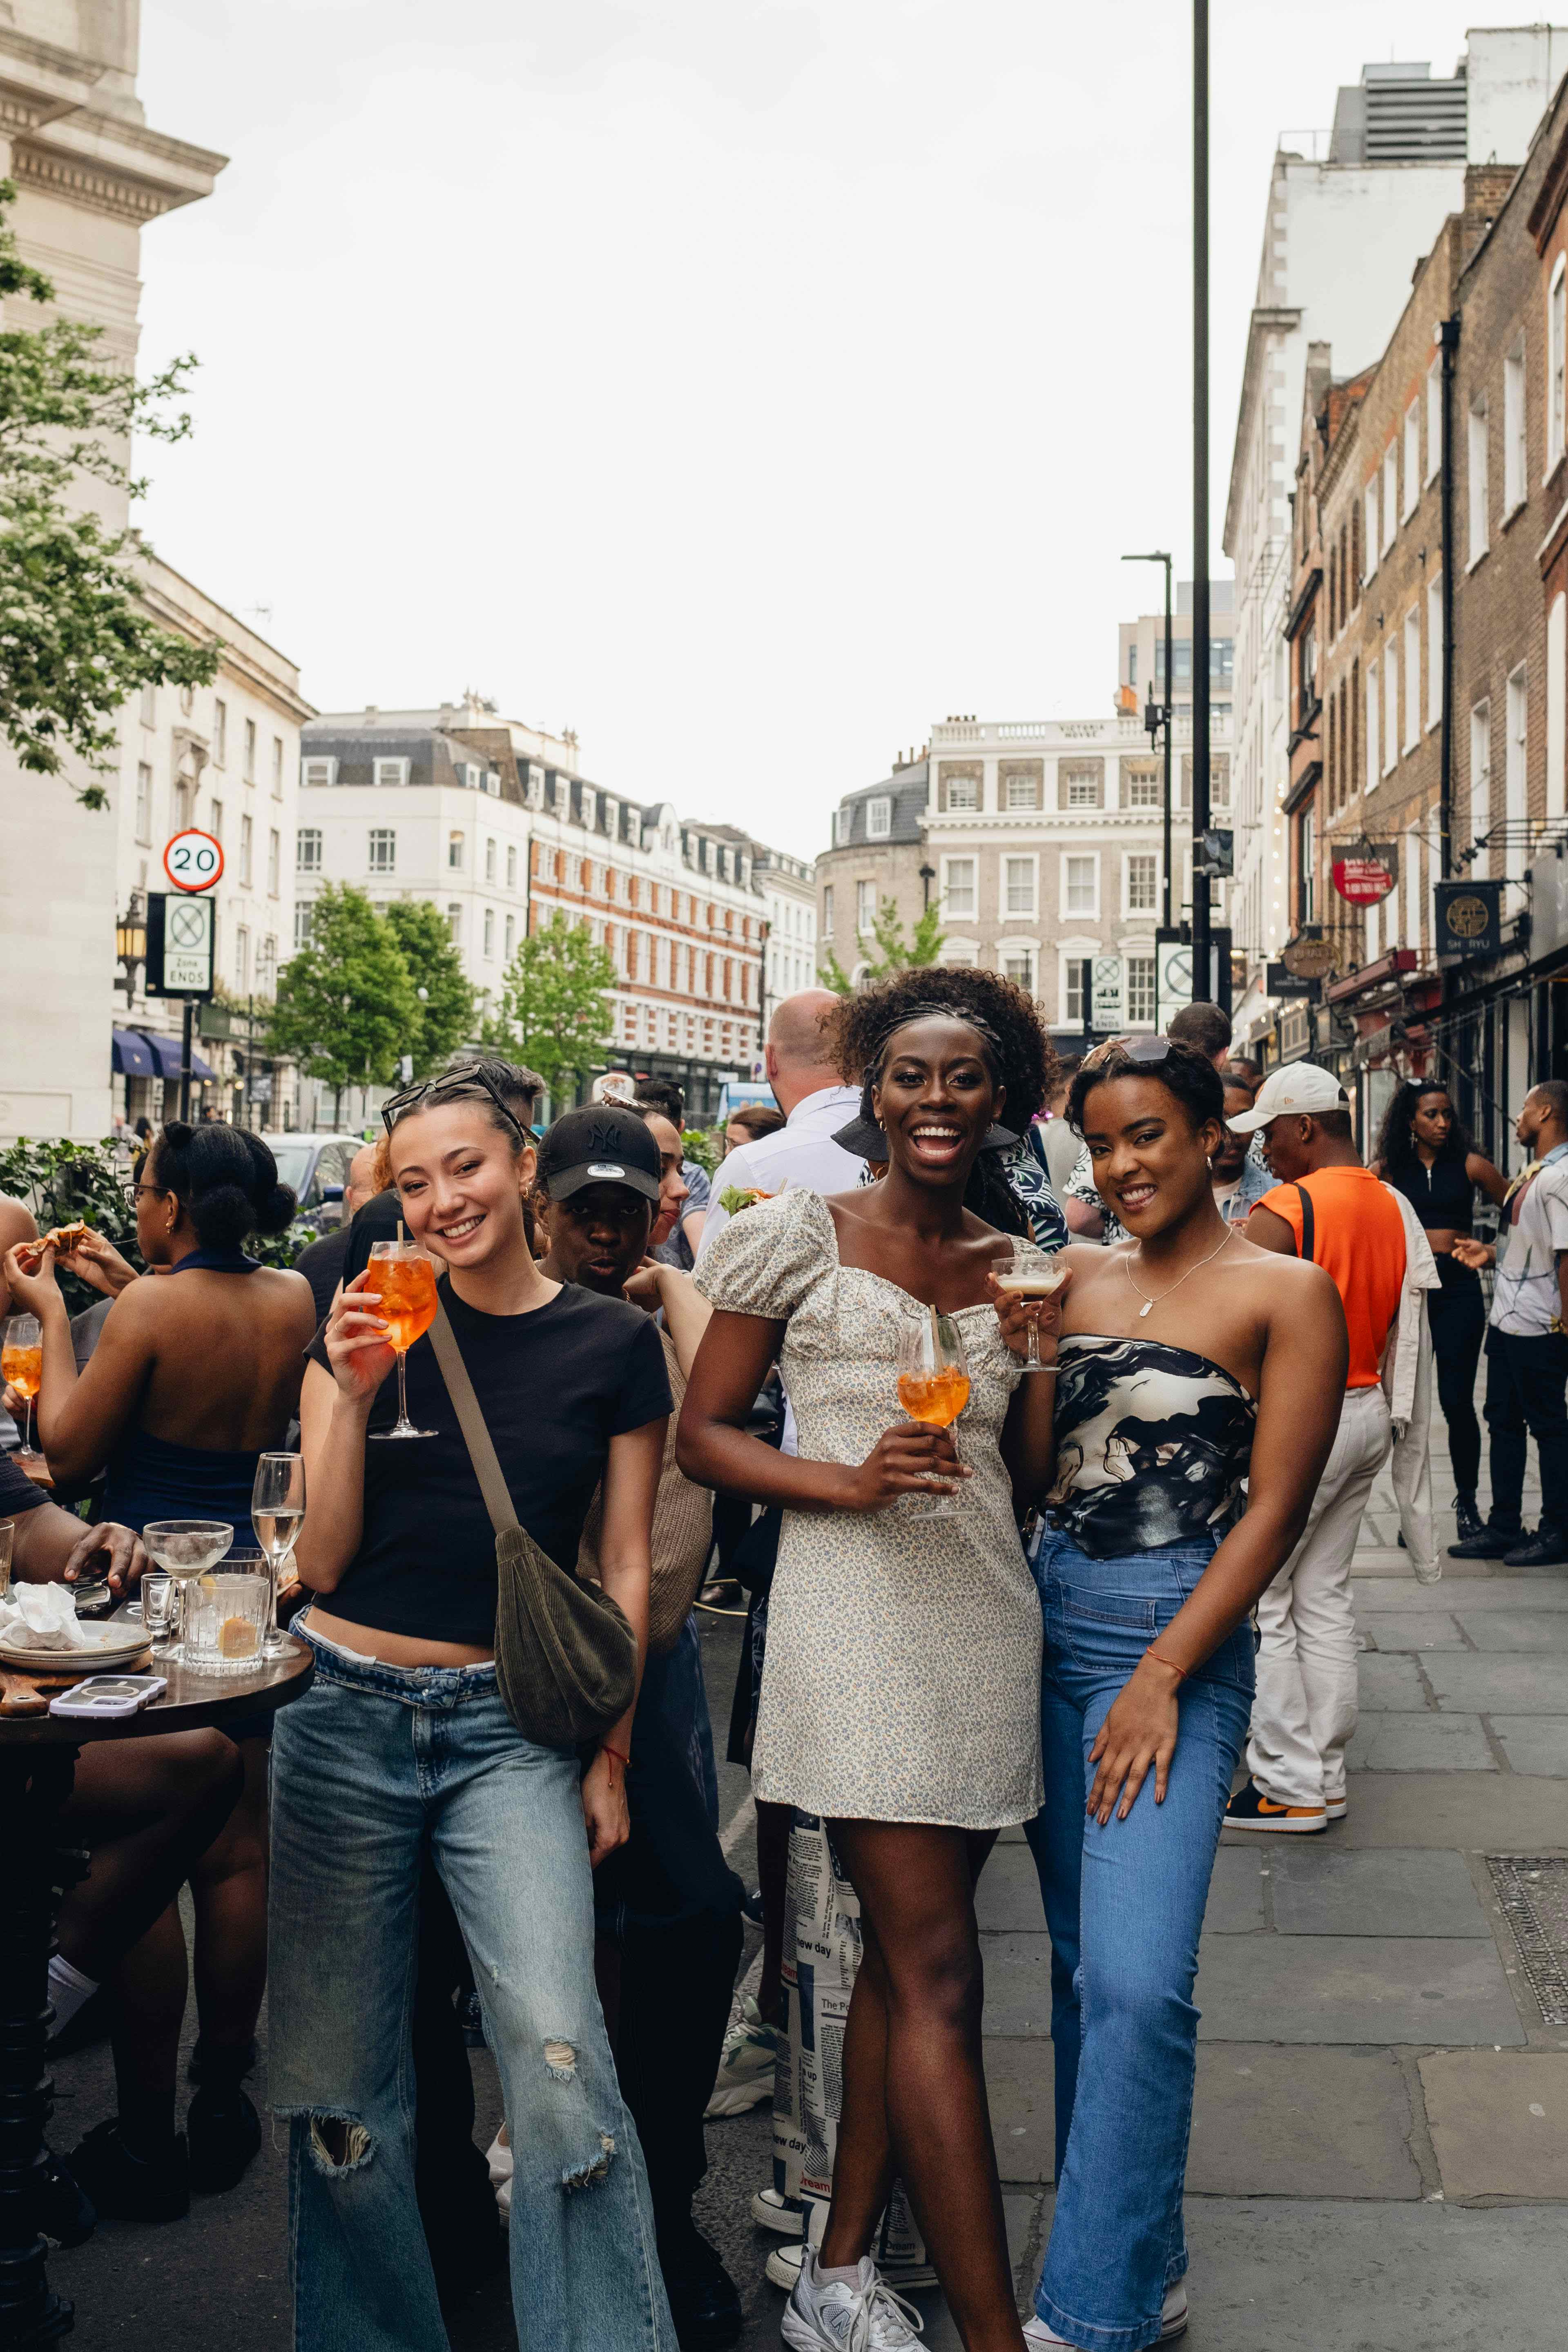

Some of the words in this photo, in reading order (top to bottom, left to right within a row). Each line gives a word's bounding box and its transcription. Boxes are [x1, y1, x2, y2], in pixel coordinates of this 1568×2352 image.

[175, 848, 214, 871] 20
[177, 957, 199, 967] Zone
[170, 970, 204, 984] ENDS
[587, 1123, 622, 1153] NY
[815, 1942, 831, 1959] day
[821, 1998, 837, 2010] The
[807, 2071, 817, 2082] up
[789, 2138, 806, 2154] day
